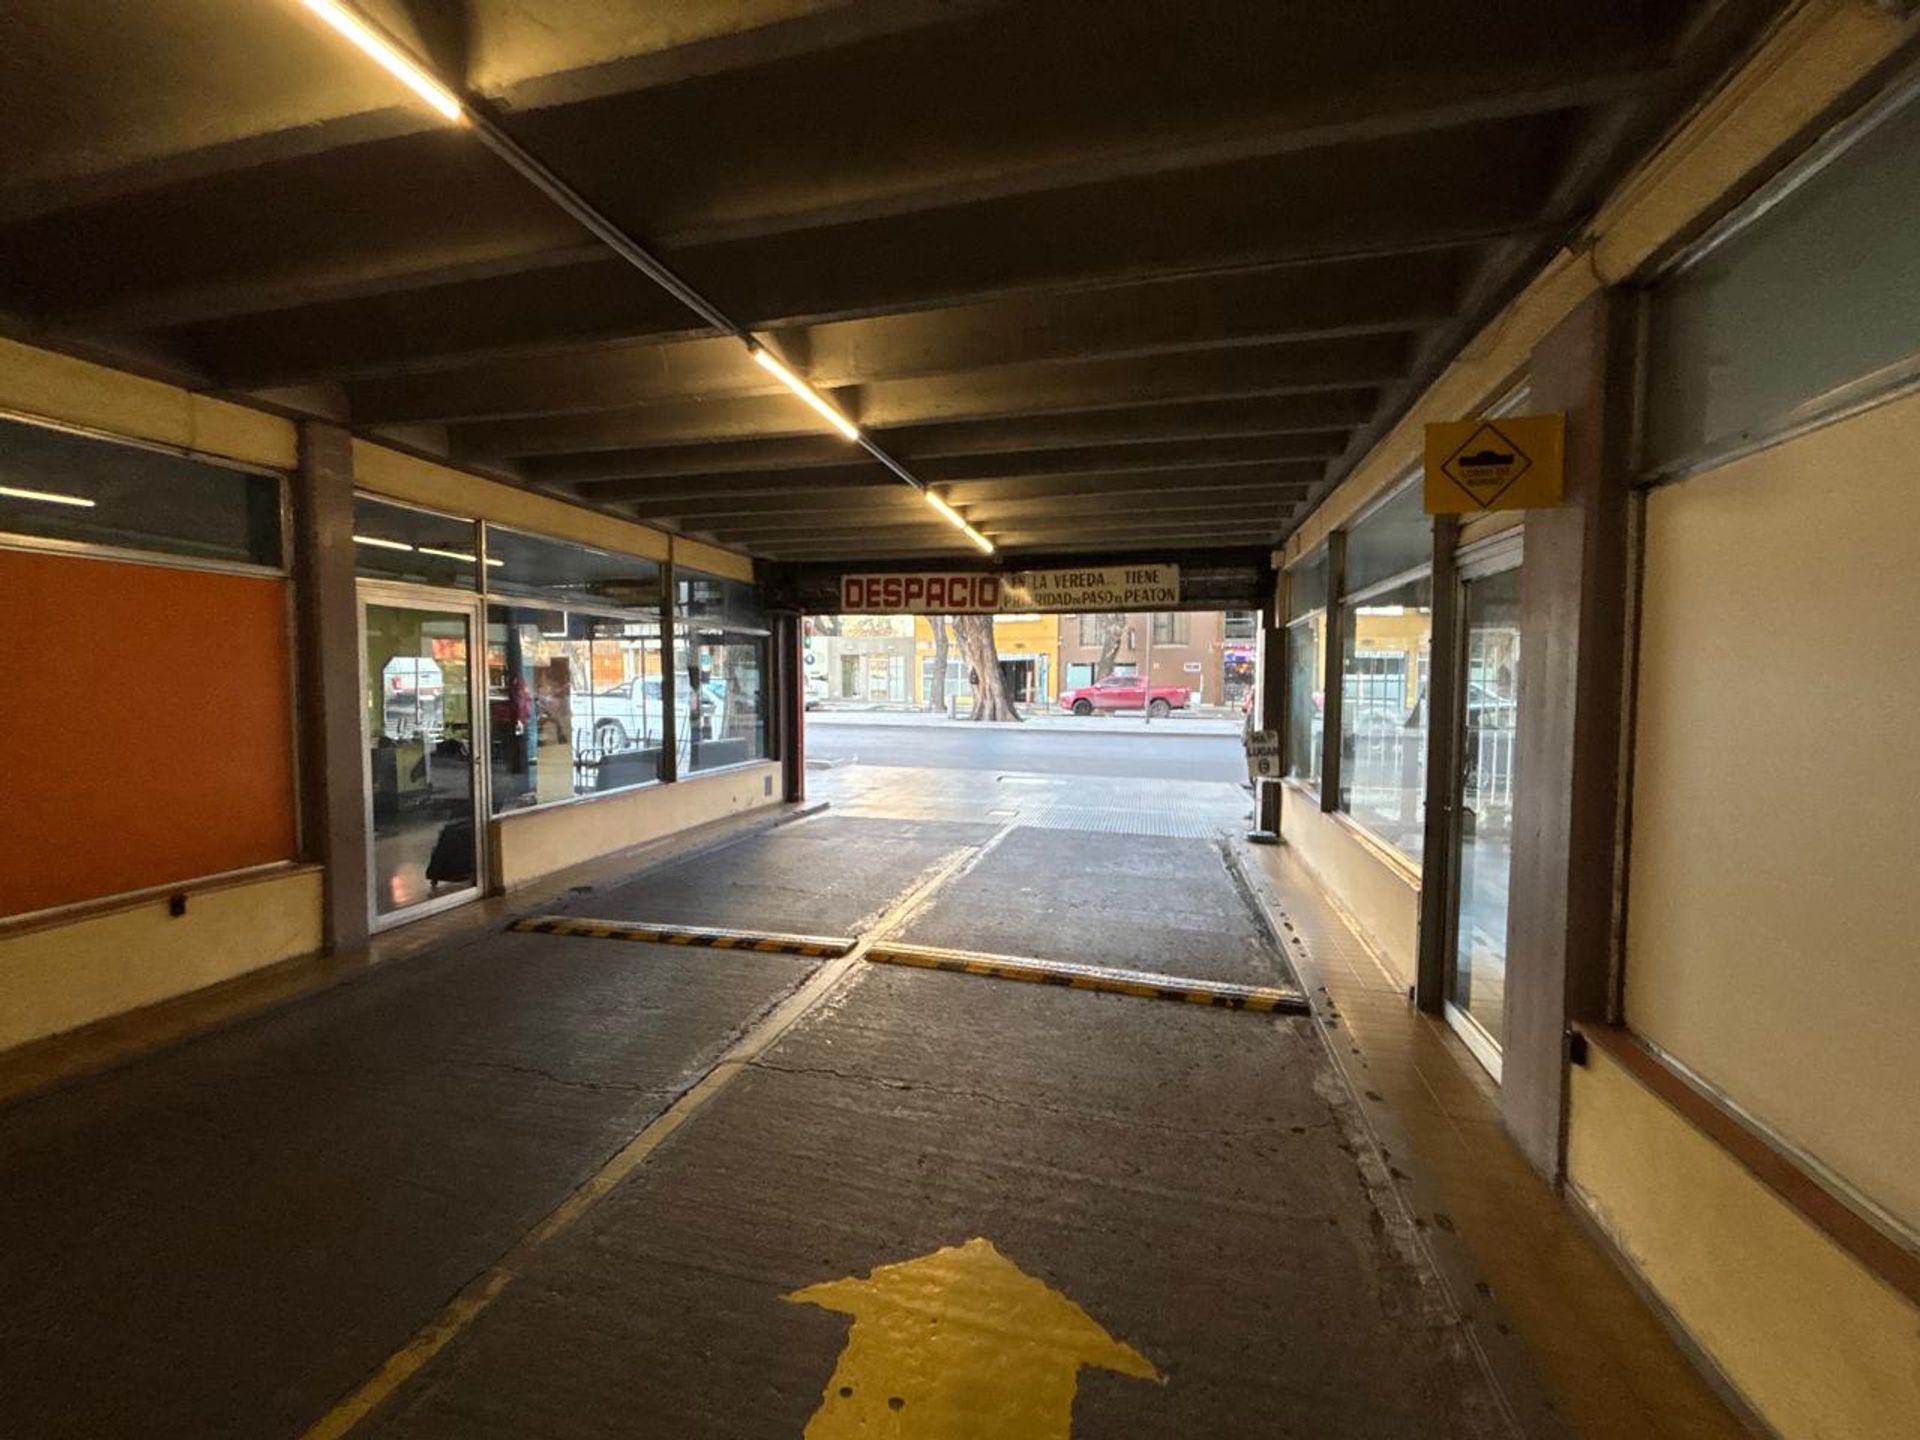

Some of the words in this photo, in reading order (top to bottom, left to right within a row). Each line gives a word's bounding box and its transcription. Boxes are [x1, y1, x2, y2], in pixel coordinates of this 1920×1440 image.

[1033, 574, 1048, 589] LA
[1125, 569, 1160, 585] TIENE
[845, 576, 1000, 608] DESPACIO
[1082, 590, 1113, 605] PASO
[1125, 587, 1175, 603] PEATON
